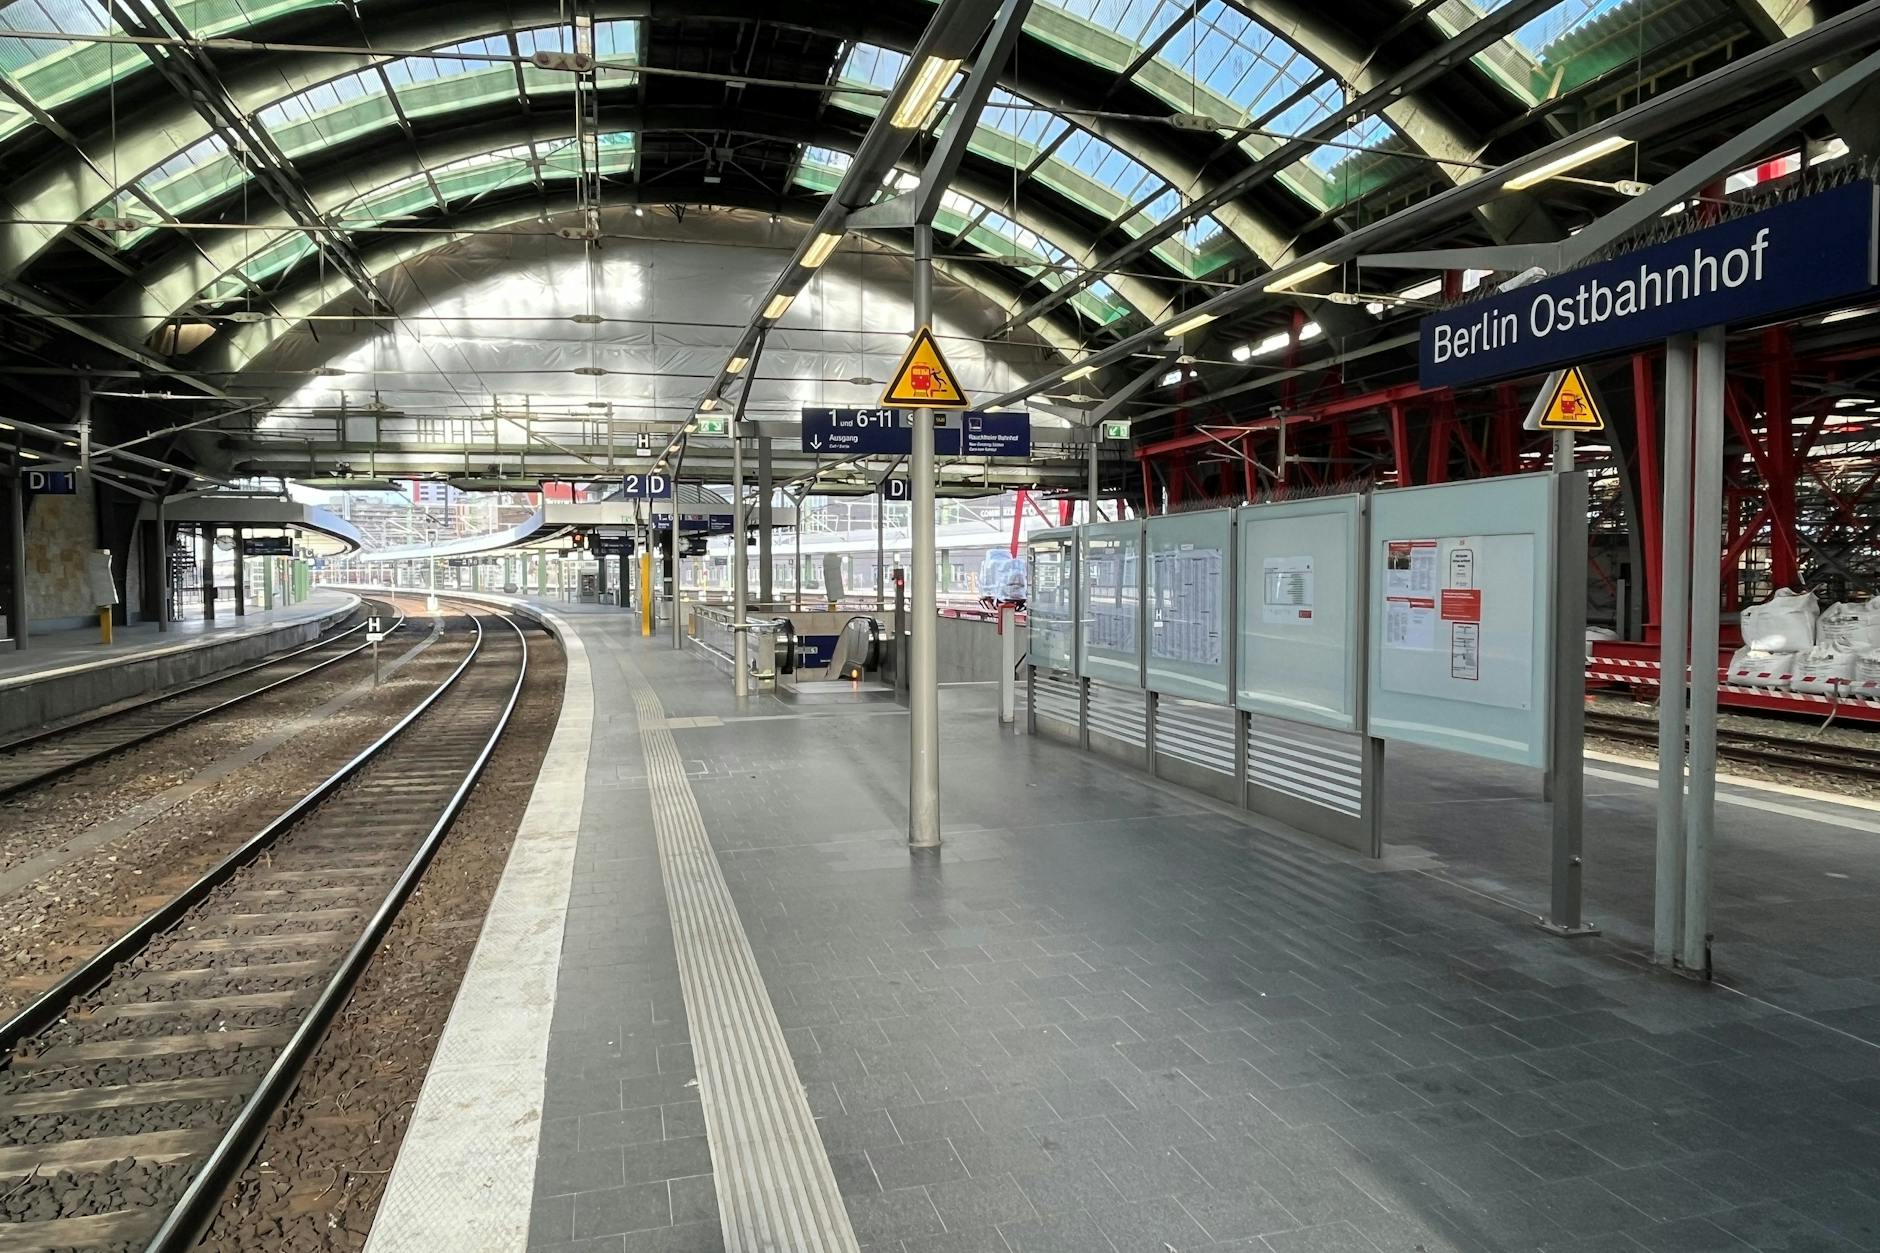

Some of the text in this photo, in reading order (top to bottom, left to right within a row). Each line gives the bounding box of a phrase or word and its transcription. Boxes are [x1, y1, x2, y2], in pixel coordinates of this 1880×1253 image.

[1433, 228, 1770, 364] Berlin Ostbahnhof
[828, 409, 837, 427] 1
[857, 409, 893, 428] 6-11
[638, 434, 649, 448] H
[829, 433, 859, 443] Ausgang
[29, 472, 73, 490] D 1
[626, 475, 665, 493] 2 D
[892, 480, 904, 497] D
[368, 617, 380, 632] H
